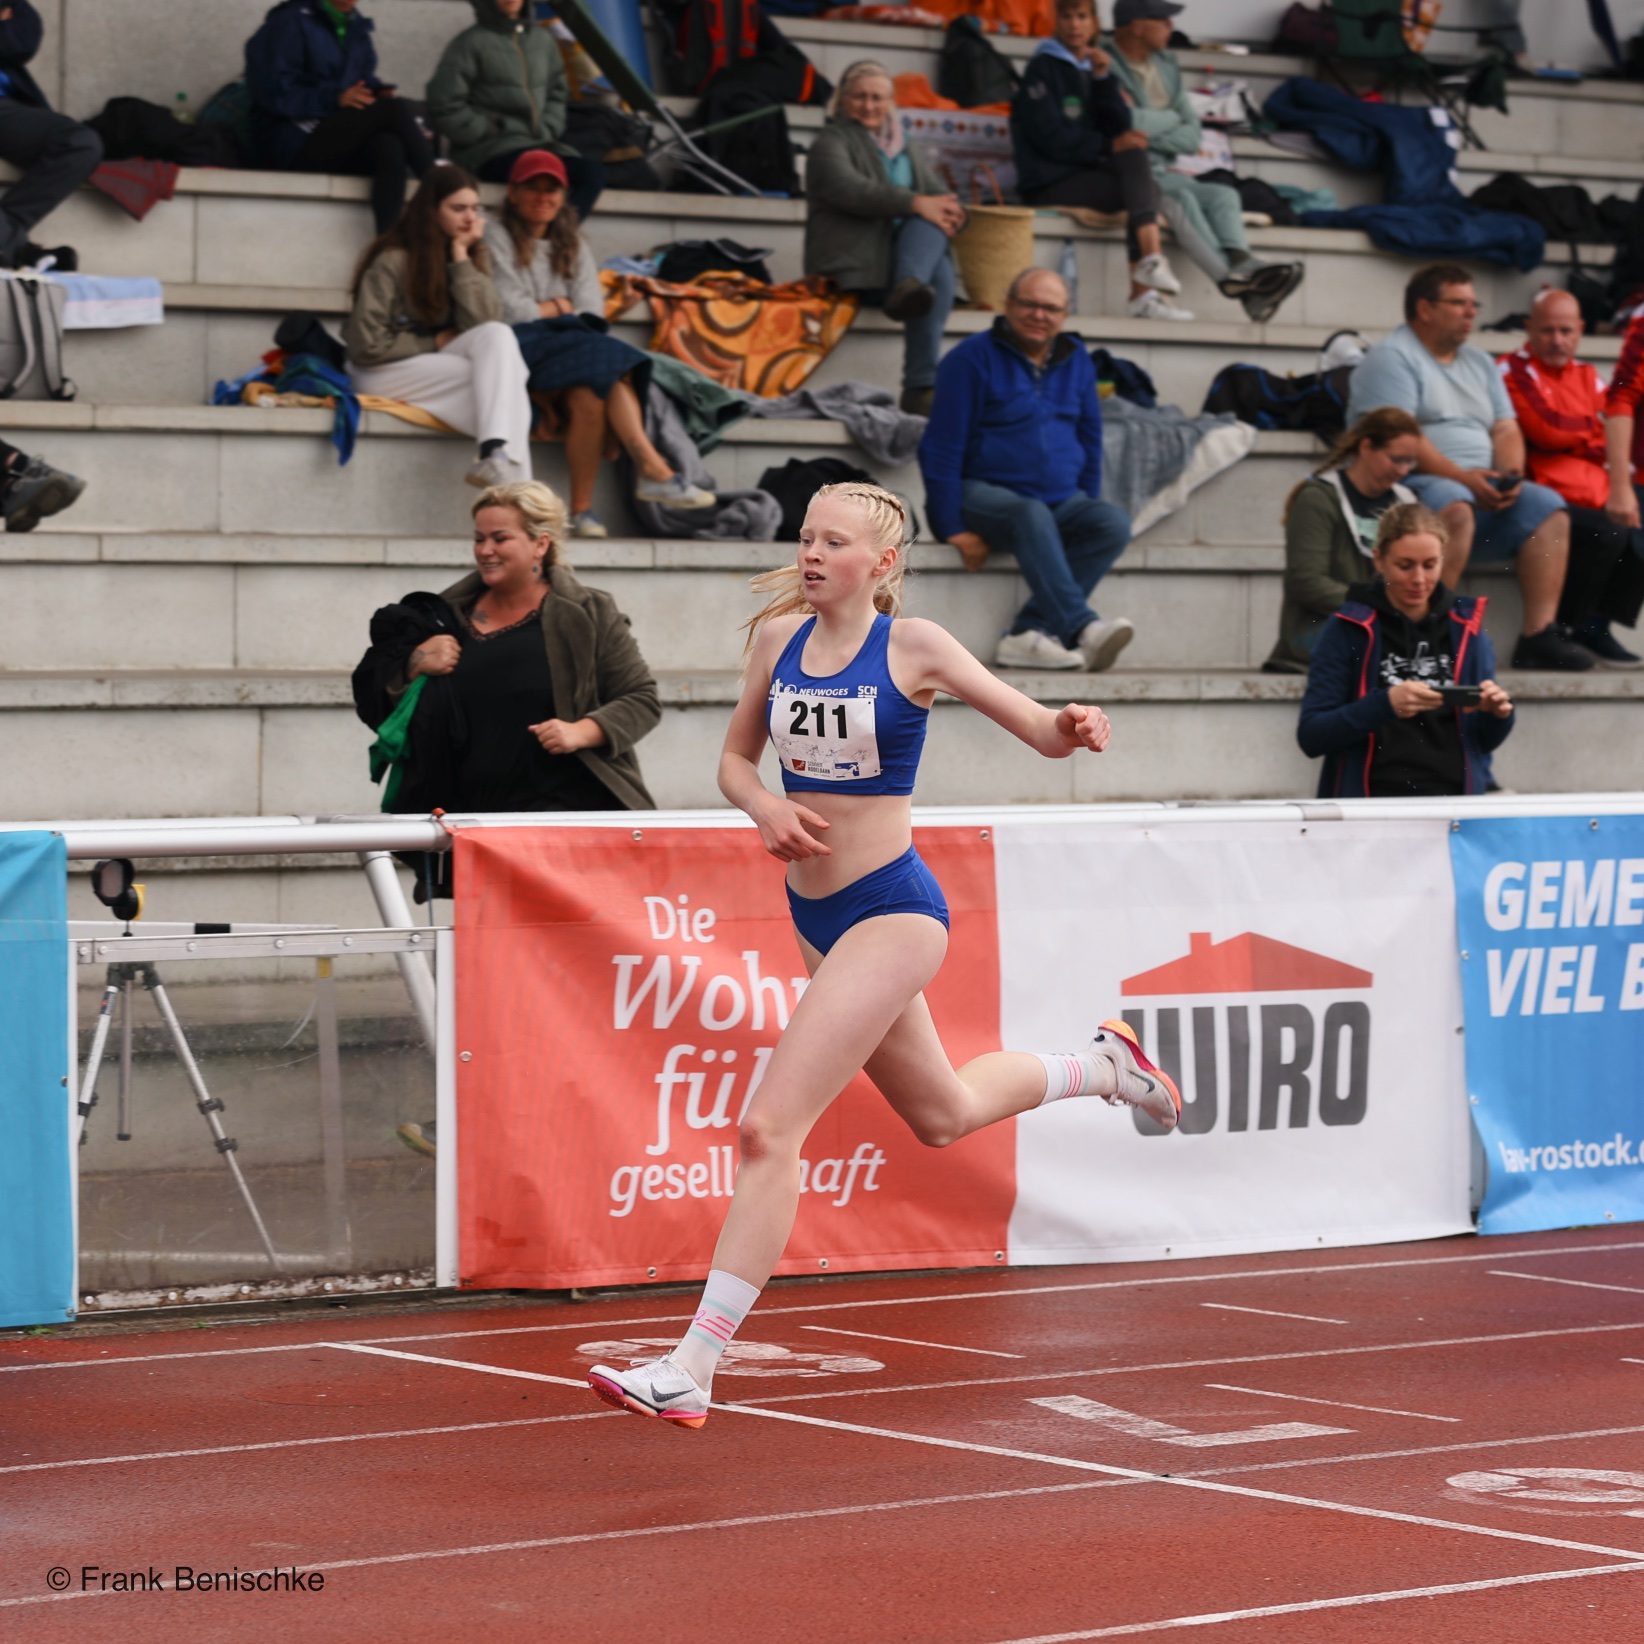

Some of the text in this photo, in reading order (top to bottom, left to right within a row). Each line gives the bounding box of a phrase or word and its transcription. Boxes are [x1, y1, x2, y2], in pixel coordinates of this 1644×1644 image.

[799, 688, 849, 696] NEUWOGES
[857, 685, 878, 695] SCN
[789, 700, 848, 739] 211
[643, 894, 716, 943] Die
[1486, 945, 1605, 1017] VIEL
[1121, 1001, 1370, 1136] WIRO
[1498, 1132, 1644, 1173] lav-rostock.
